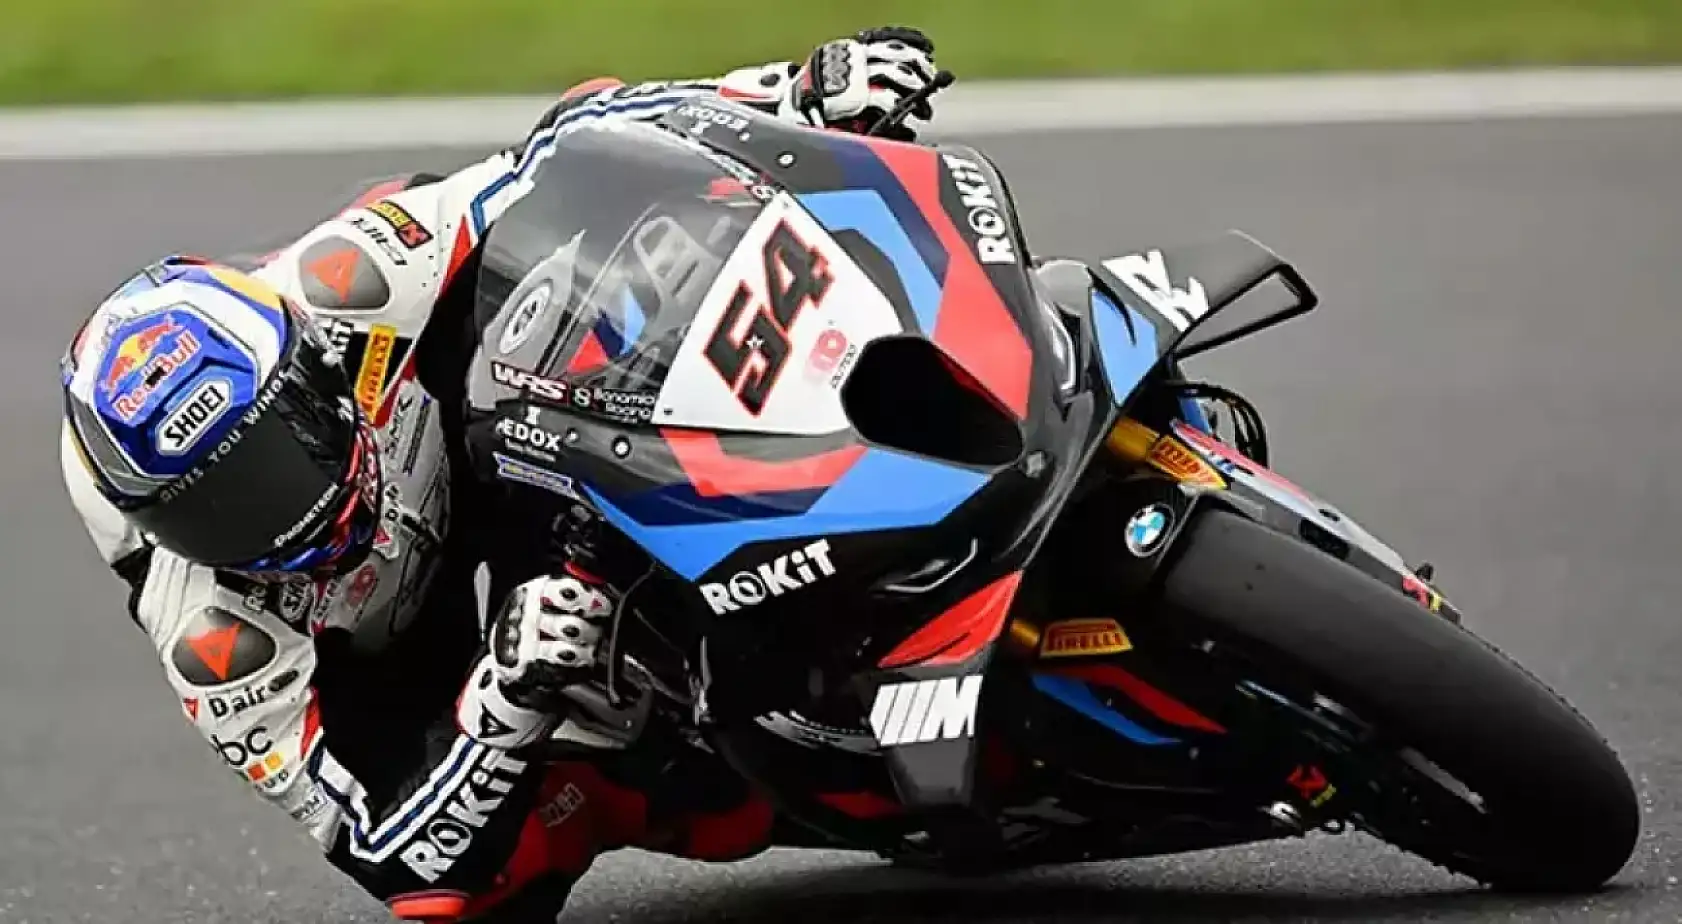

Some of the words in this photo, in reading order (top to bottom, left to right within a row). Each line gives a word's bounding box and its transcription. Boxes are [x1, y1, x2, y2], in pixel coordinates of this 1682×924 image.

[703, 217, 834, 417] 54
[163, 384, 226, 447] SHOEI
[207, 427, 242, 464] YOU
[503, 418, 561, 452] EDOX
[700, 538, 836, 615] ROKiT
[401, 745, 528, 883] ROKiT
